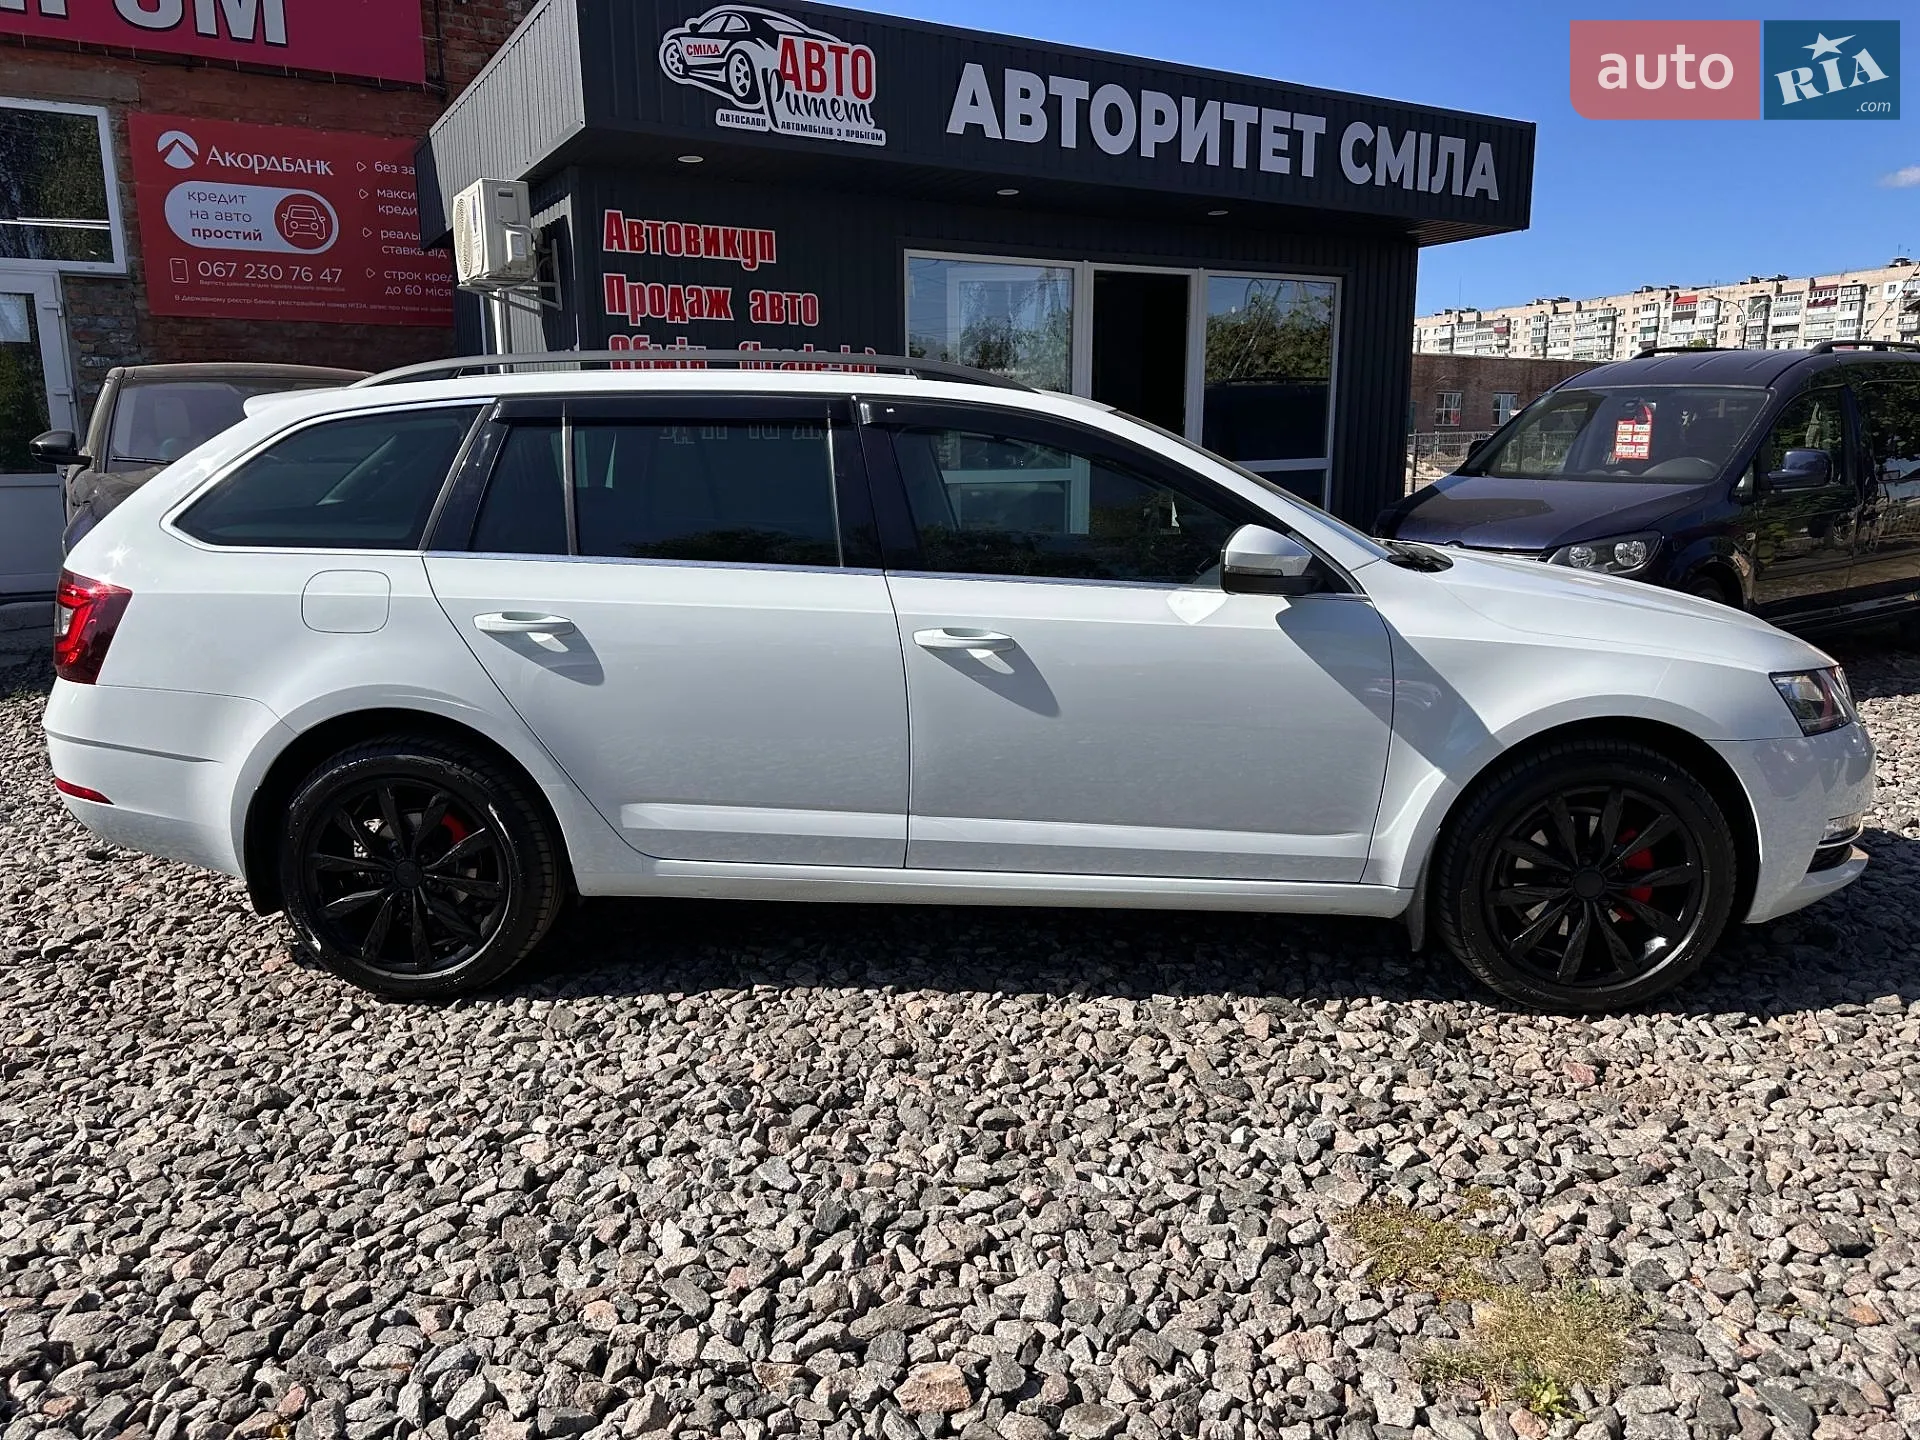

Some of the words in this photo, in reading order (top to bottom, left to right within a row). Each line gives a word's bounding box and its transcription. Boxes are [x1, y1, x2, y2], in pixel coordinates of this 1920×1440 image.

[686, 43, 721, 56] СМІЛА
[779, 37, 873, 101] АВТО
[719, 112, 767, 127] АВТОСАЛОН
[780, 120, 834, 136] АВТОМОБІЛІВ
[845, 129, 883, 142] ПРОБІГОМ
[945, 62, 1327, 178] АВТОРИТЕТ
[1340, 121, 1500, 201] СМІЛА
[374, 161, 398, 174] без
[187, 191, 248, 205] кредит
[376, 188, 417, 200] макси
[189, 209, 209, 220] на
[214, 211, 253, 223] авто
[378, 204, 418, 216] креди
[191, 227, 263, 242] простий
[380, 229, 421, 241] реаль
[602, 208, 777, 272] Автовикуп
[381, 245, 425, 257] ставка
[197, 260, 238, 278] 067
[244, 263, 283, 280] 230
[289, 266, 313, 282] 76
[319, 267, 342, 284] 47
[384, 270, 422, 281] строк
[384, 286, 402, 297] до
[404, 284, 423, 296] 60
[425, 286, 454, 298] міся
[602, 272, 735, 327] Продаж
[749, 289, 819, 328] авто
